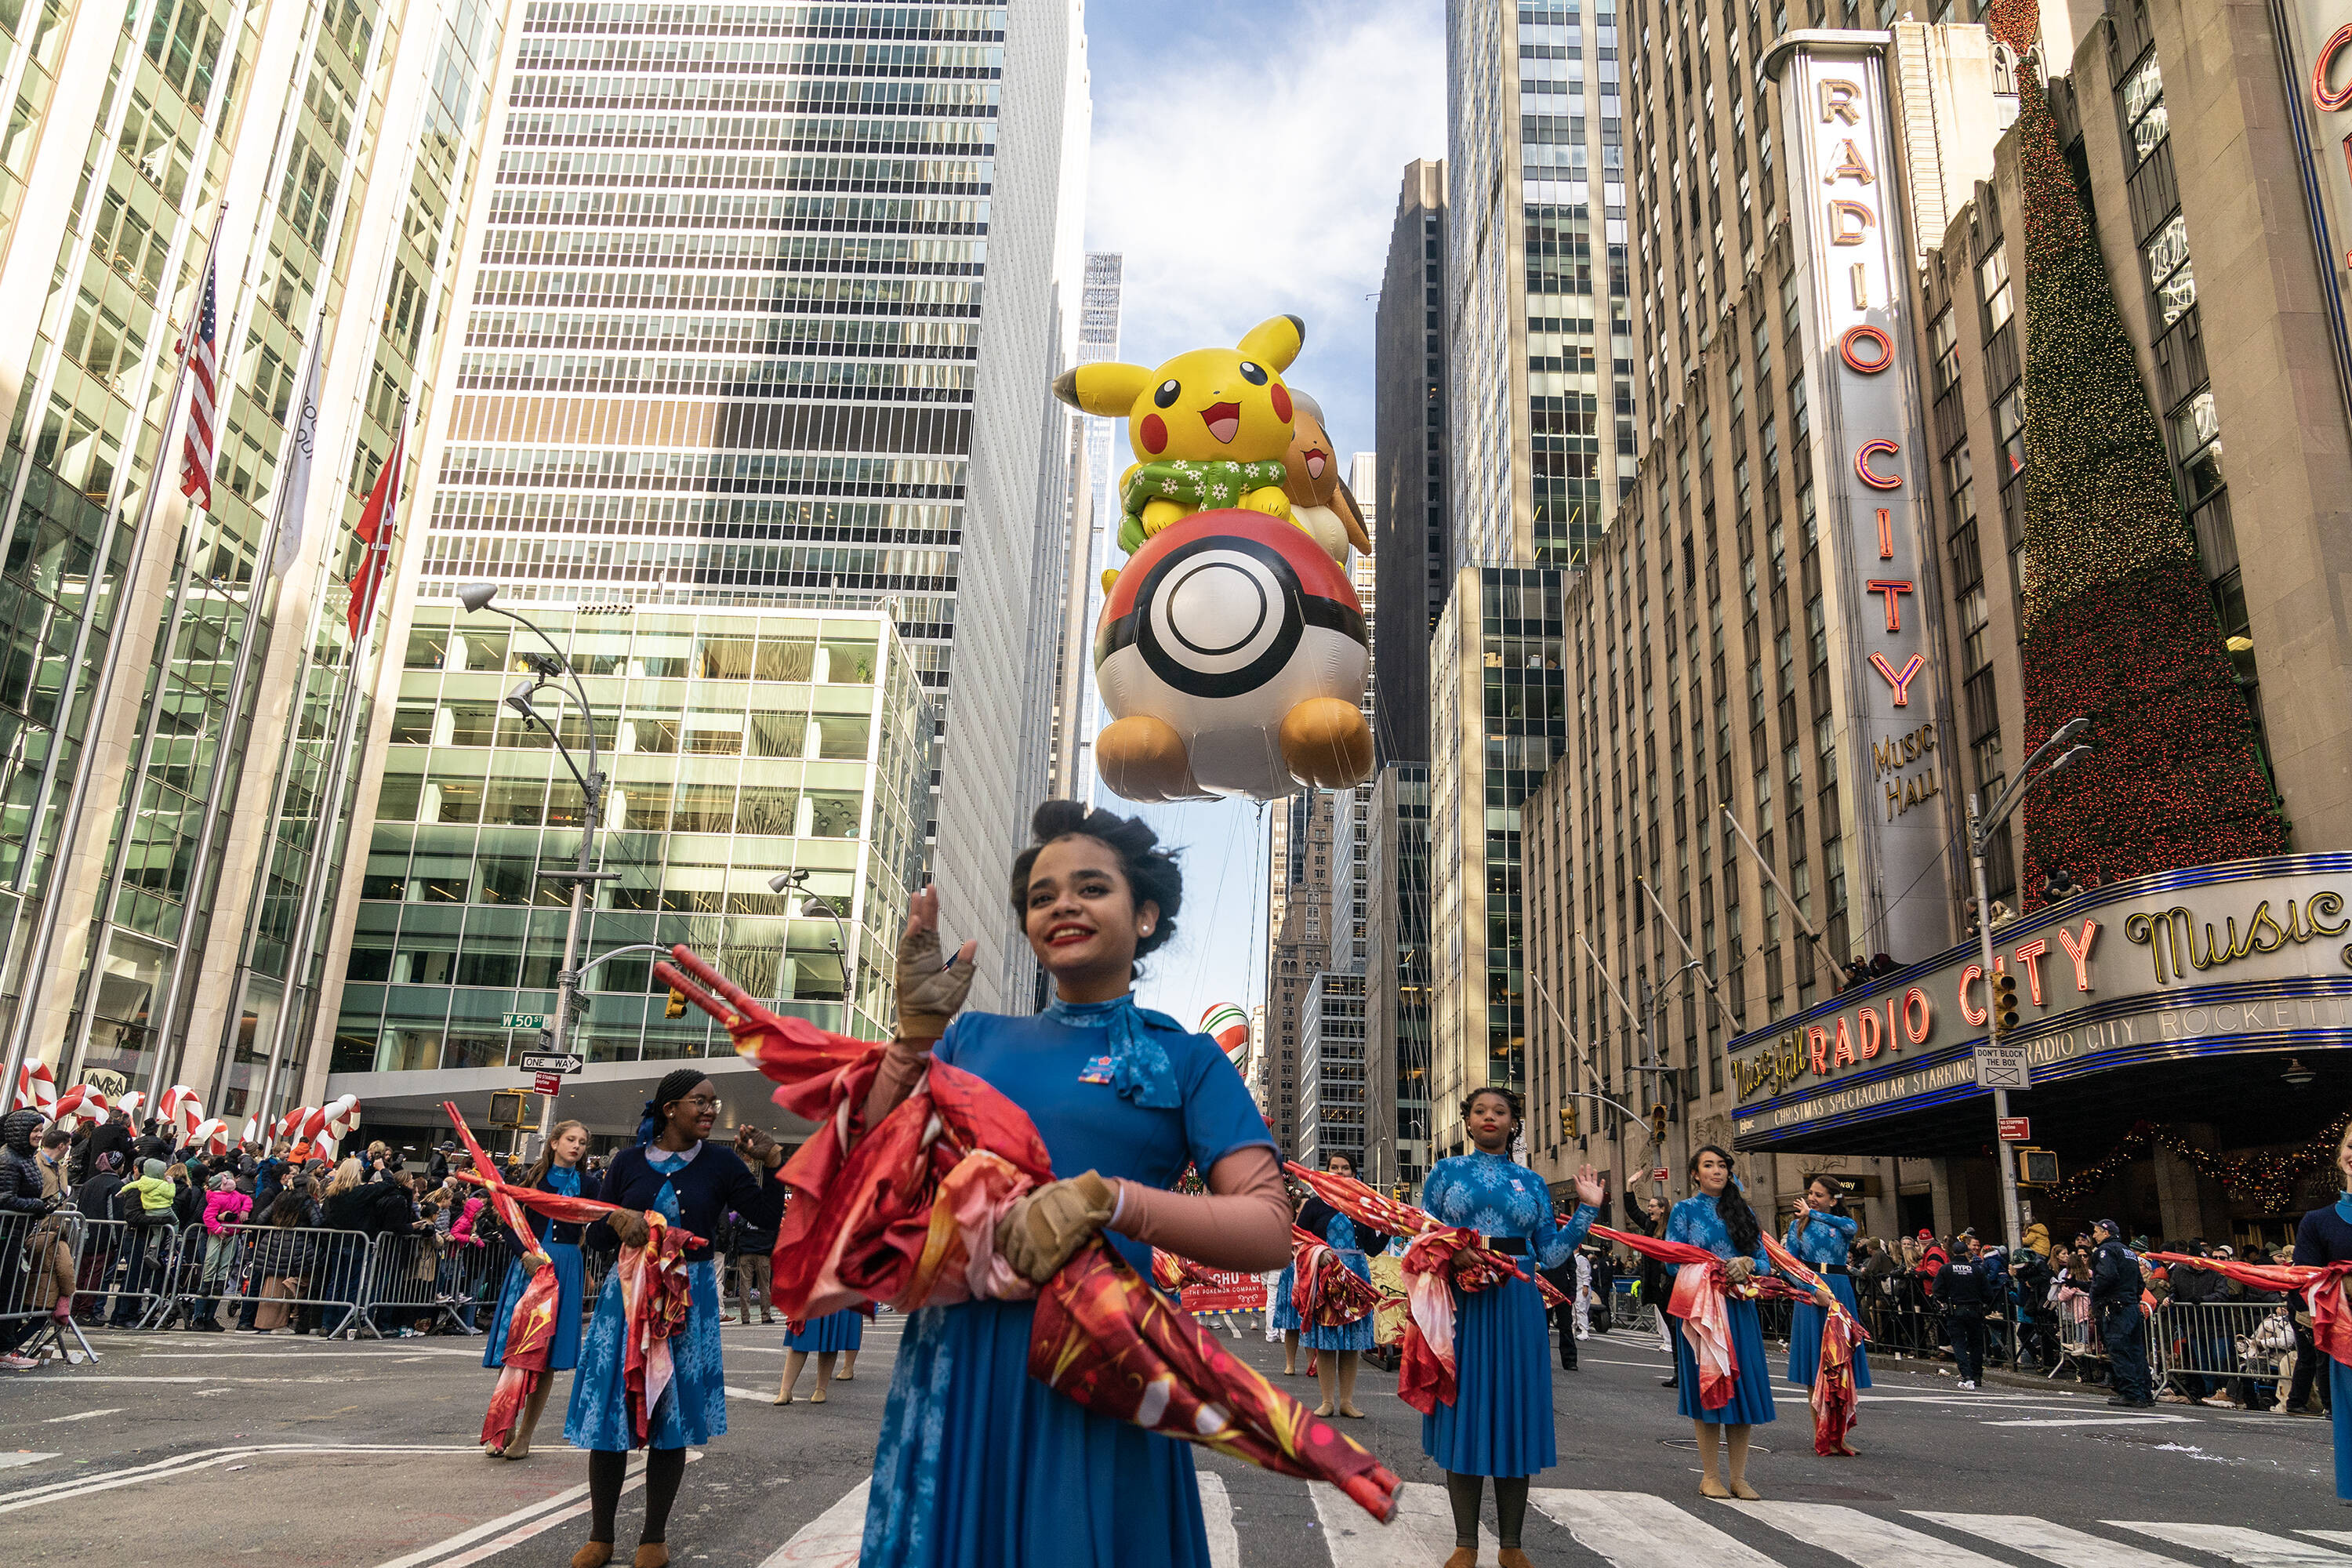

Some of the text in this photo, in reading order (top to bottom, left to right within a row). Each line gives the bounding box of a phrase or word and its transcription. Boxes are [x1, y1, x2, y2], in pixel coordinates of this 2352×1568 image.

[1819, 78, 1926, 707] RADIO CITY
[1873, 724, 1935, 782] MUSIC
[1884, 768, 1939, 822] HALL
[2125, 891, 2350, 983] Music
[503, 1014, 513, 1026] W
[515, 1015, 532, 1027] 50
[1808, 986, 1930, 1076] RADIO
[555, 1059, 575, 1068] WAY
[1774, 997, 2351, 1126] CHRISTMAS SPECTACULAR STARRING RADIO CITY ROCKETT
[1839, 1181, 1855, 1190] way
